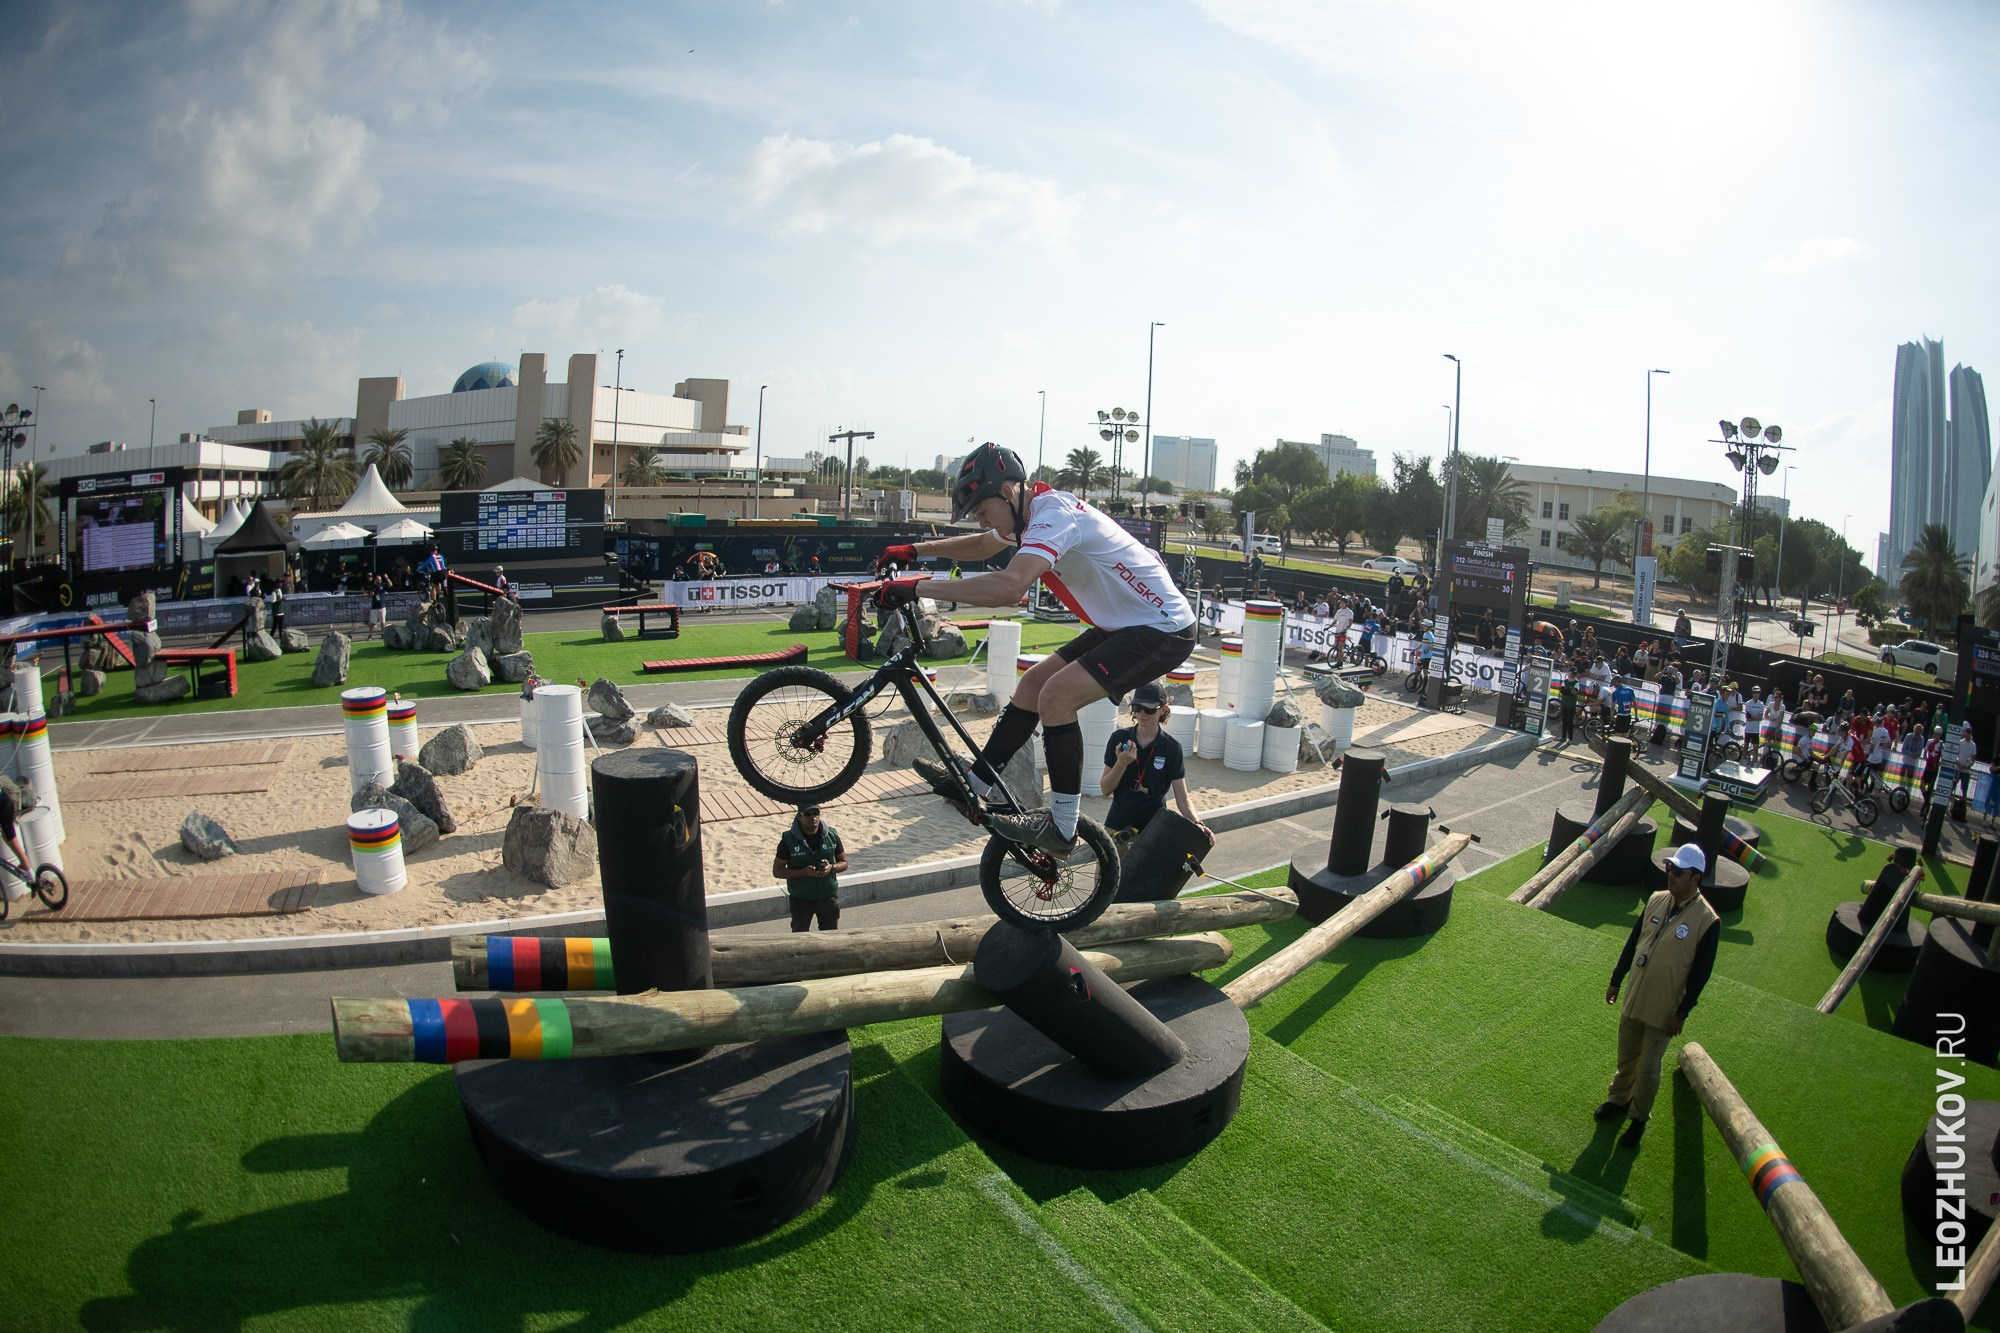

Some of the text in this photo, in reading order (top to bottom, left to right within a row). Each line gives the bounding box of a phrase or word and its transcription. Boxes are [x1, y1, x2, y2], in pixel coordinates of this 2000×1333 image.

[174, 498, 182, 557] #Abudhabi2024
[1473, 549, 1494, 558] FINISH
[716, 582, 788, 600] TISSOT
[1111, 561, 1165, 609] POLSKA
[86, 591, 119, 606] ABU DHABI
[1530, 668, 1550, 679] FINISH
[1533, 676, 1543, 692] 2
[1690, 705, 1711, 716] START
[1692, 714, 1704, 732] 3
[1720, 782, 1740, 795] UCI
